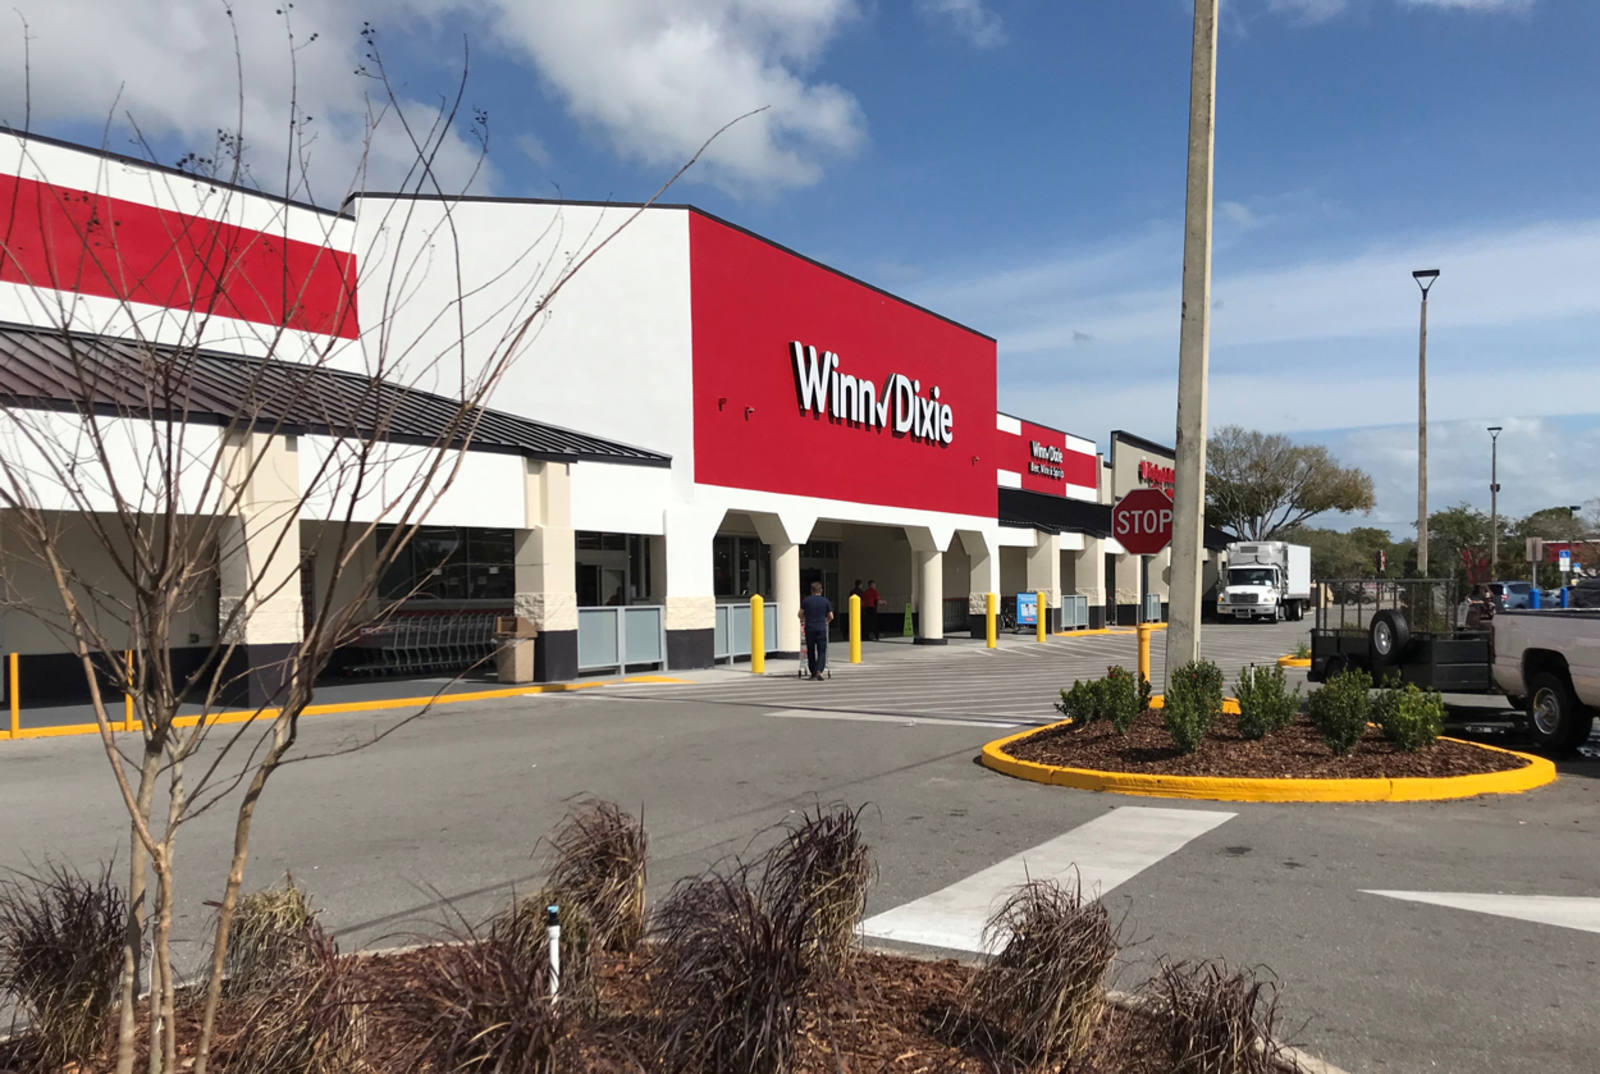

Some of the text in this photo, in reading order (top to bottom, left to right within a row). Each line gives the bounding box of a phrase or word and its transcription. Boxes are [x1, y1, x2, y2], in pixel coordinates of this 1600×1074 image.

[791, 341, 953, 443] Winn Dixie
[1117, 509, 1172, 535] STOP
